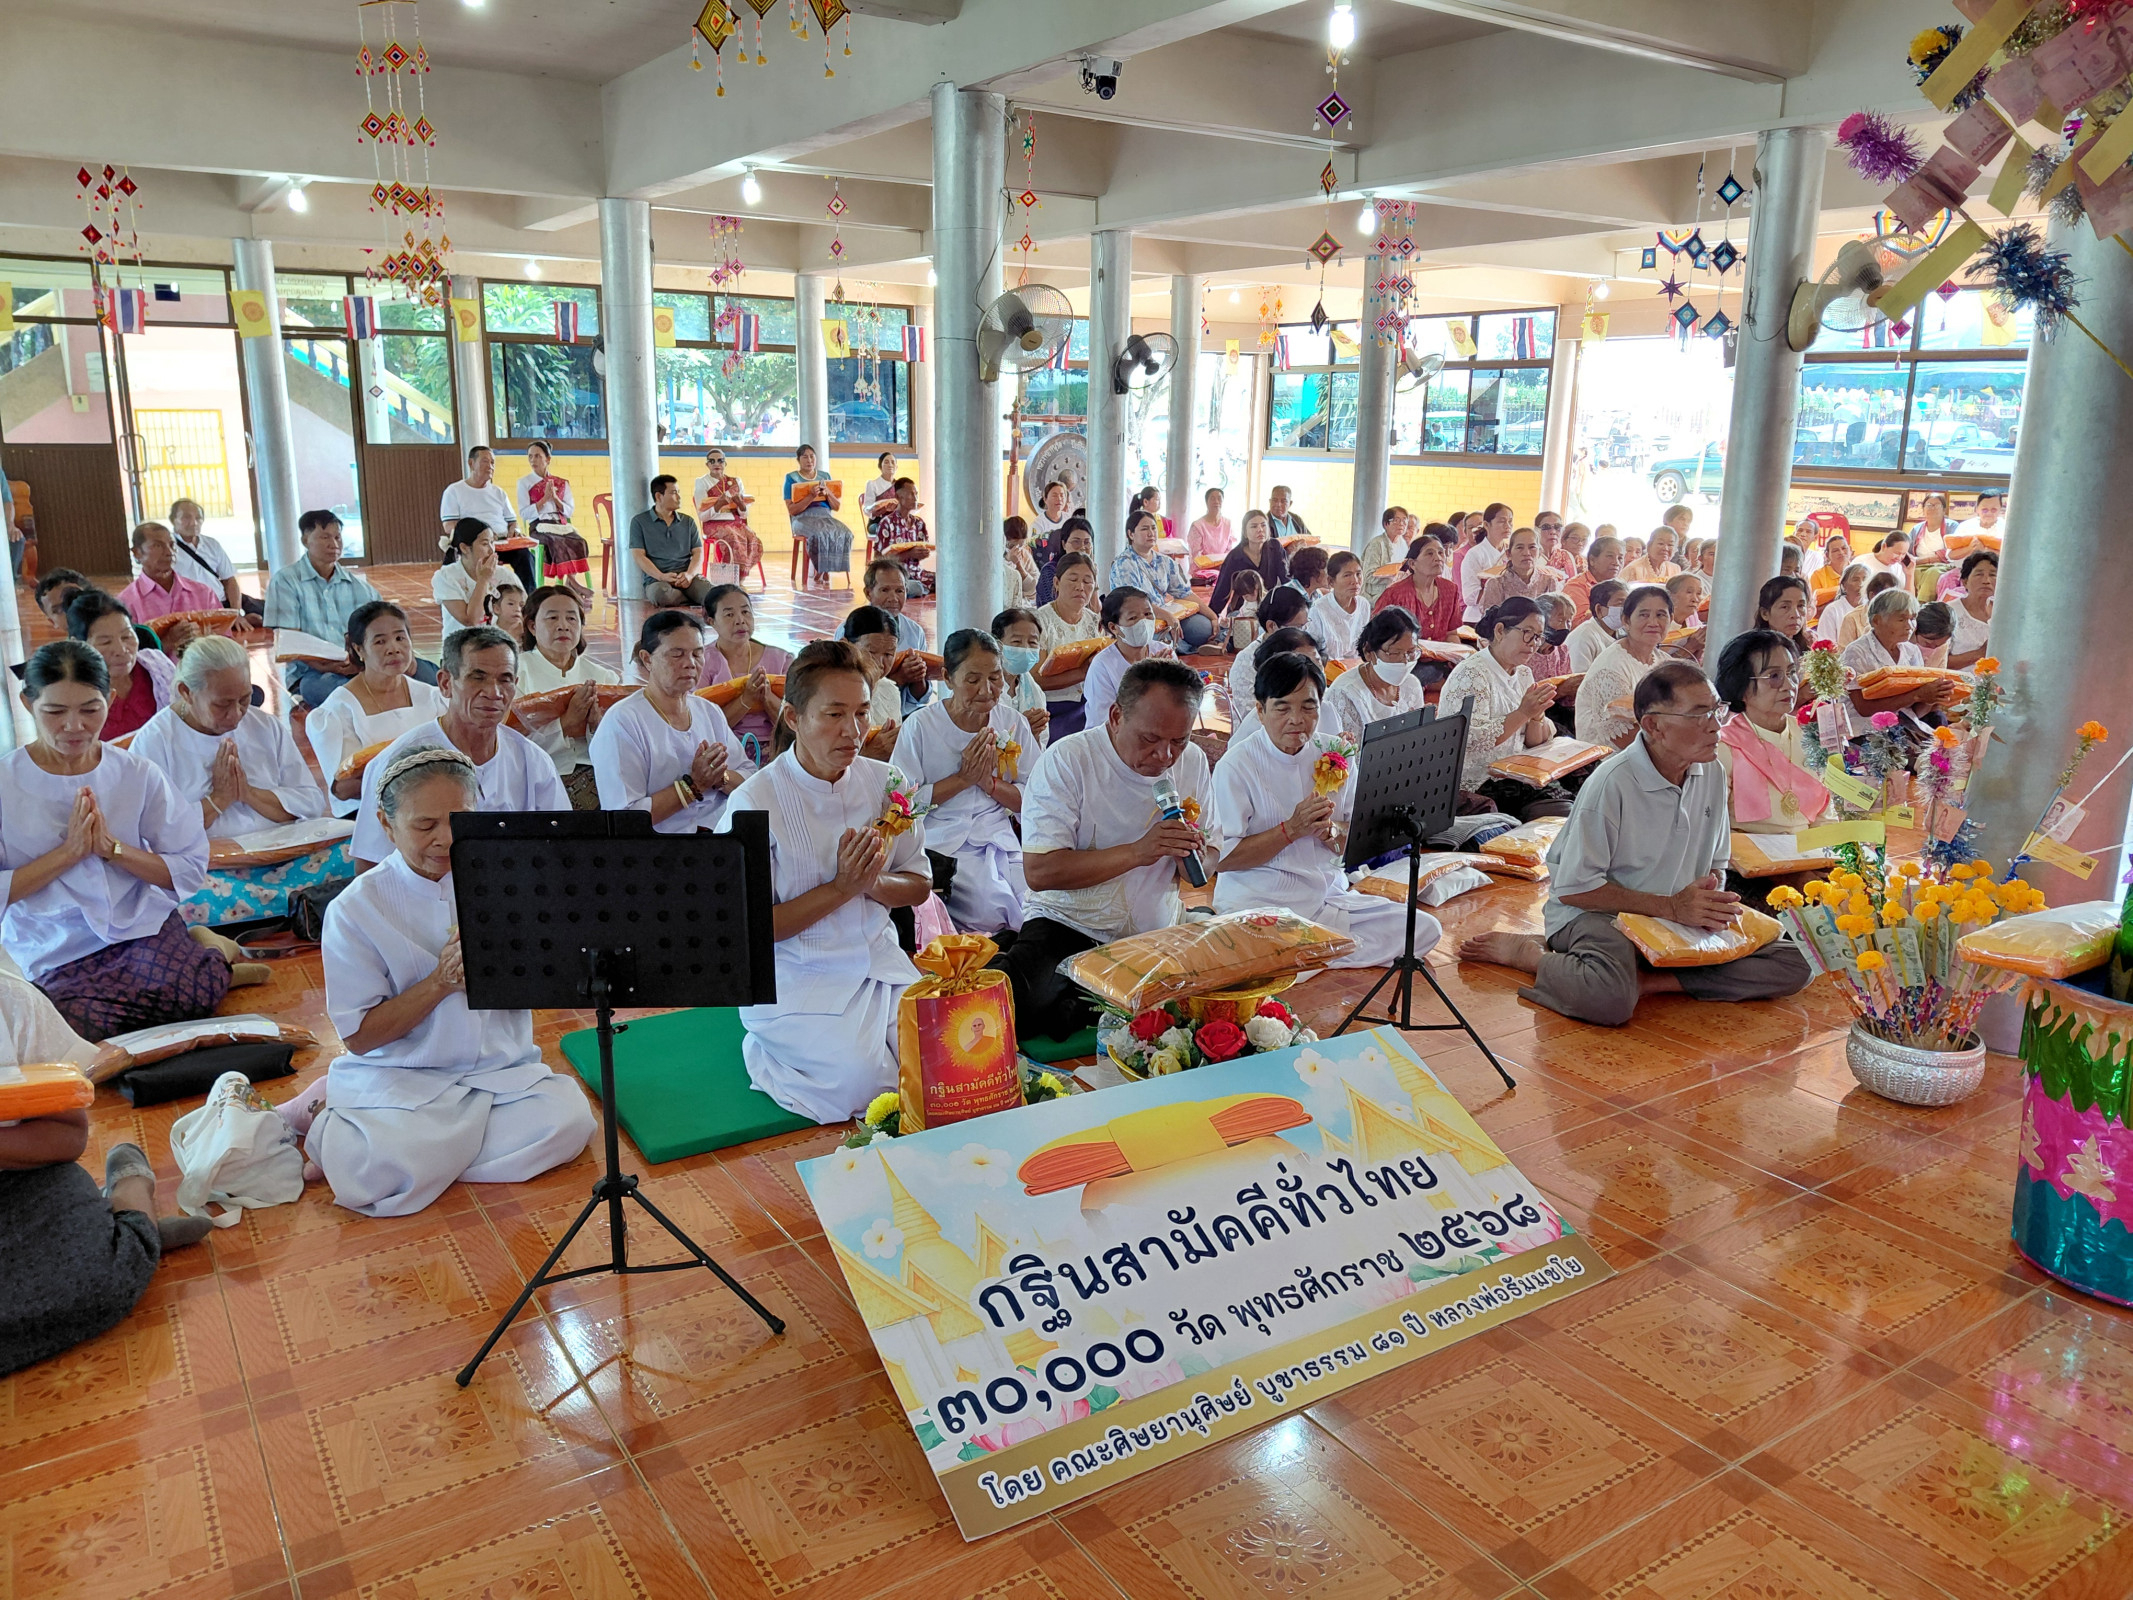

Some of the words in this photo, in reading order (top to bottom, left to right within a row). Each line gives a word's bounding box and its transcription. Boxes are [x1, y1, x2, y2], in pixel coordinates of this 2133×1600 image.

[937, 1328, 1165, 1434] ๓๐,๐๐๐
[1169, 1308, 1227, 1346] วัด
[1228, 1249, 1405, 1336] พุทธศักราช
[1398, 1193, 1543, 1260] ๒๕๖๘
[978, 1152, 1438, 1332] กฐินสามัคคีทั่วไทย
[982, 1468, 1043, 1505] โดย
[1052, 1382, 1252, 1482] คณะศิษยานุศิษย์
[1257, 1341, 1367, 1403] บูชาธรรม
[1371, 1329, 1406, 1352] ๘๑
[1402, 1311, 1426, 1337] ปี
[1430, 1254, 1586, 1328] หลวงพ่อธัมมชโย
